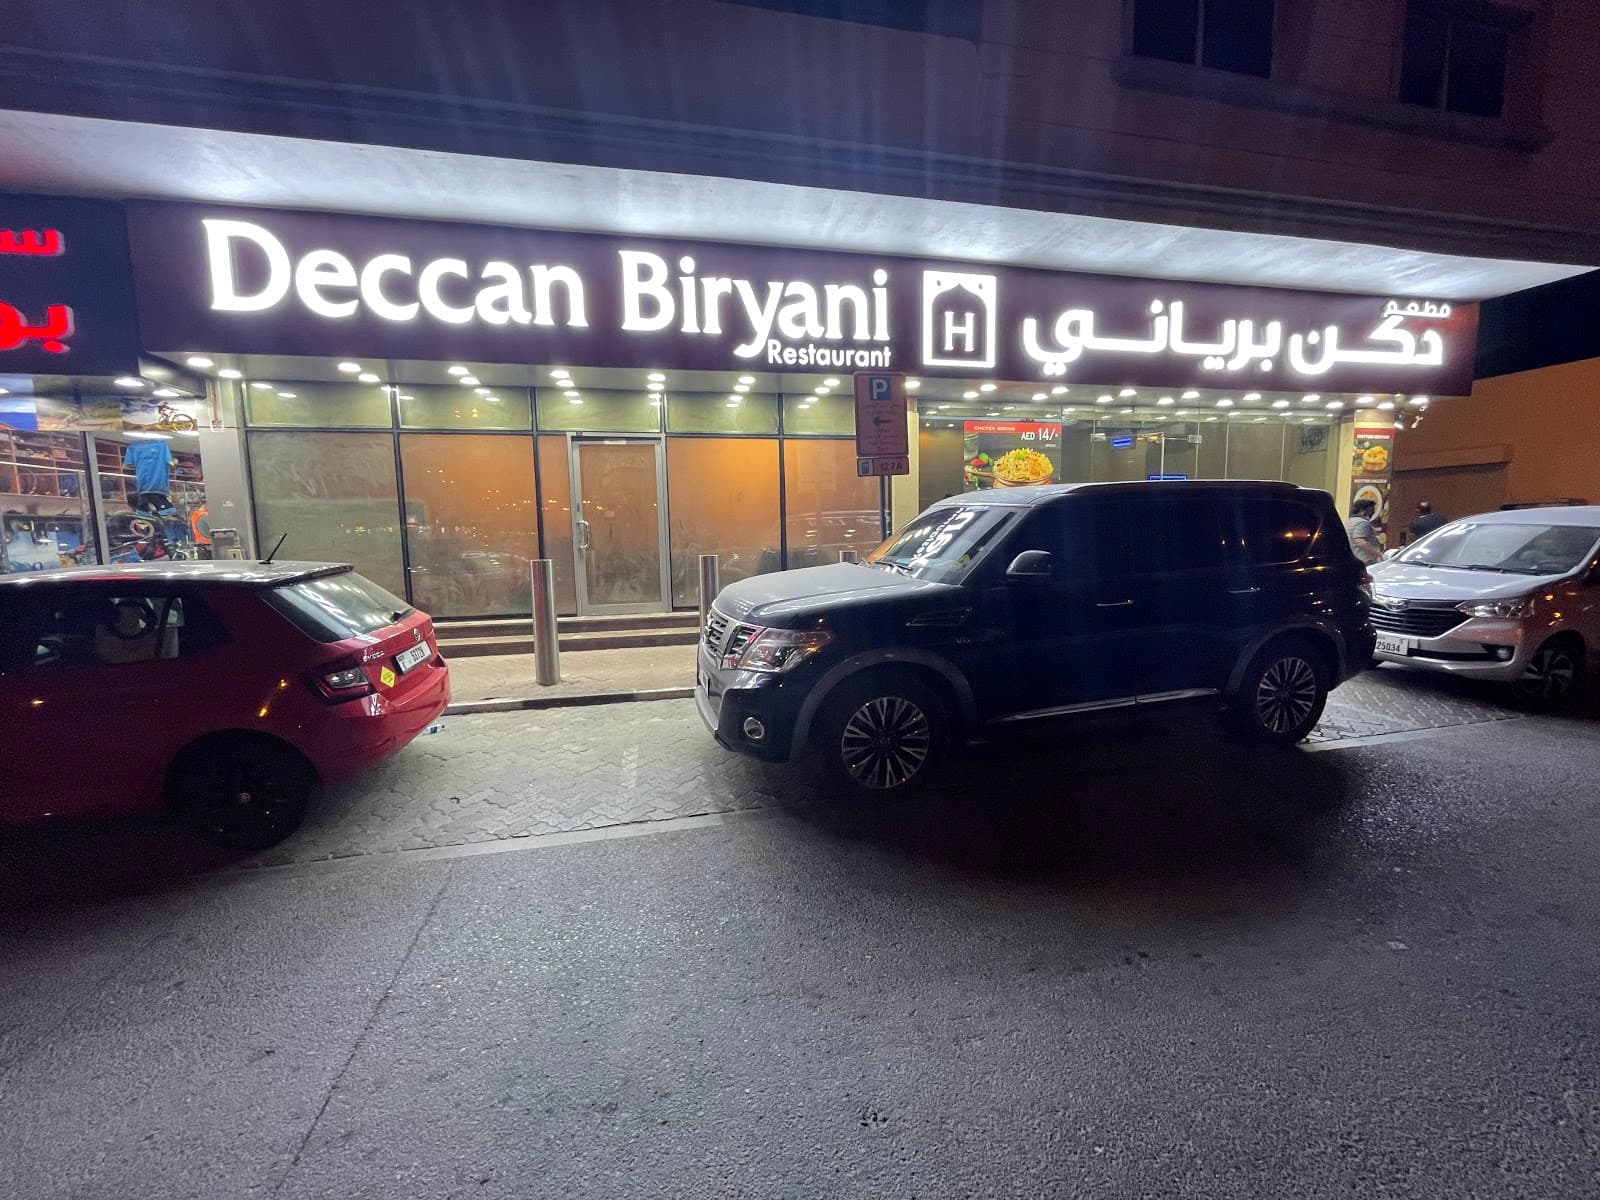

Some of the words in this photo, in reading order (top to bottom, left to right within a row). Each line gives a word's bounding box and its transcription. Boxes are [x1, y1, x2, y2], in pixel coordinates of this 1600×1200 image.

[200, 218, 590, 328] Deccan
[617, 249, 891, 359] Biryani
[1383, 300, 1451, 318] مطعم
[944, 311, 976, 352] H
[1023, 299, 1282, 377] برياني
[1287, 314, 1444, 376] دكن
[766, 338, 893, 368] Restaurant
[872, 378, 888, 400] P
[1021, 431, 1036, 441] AED
